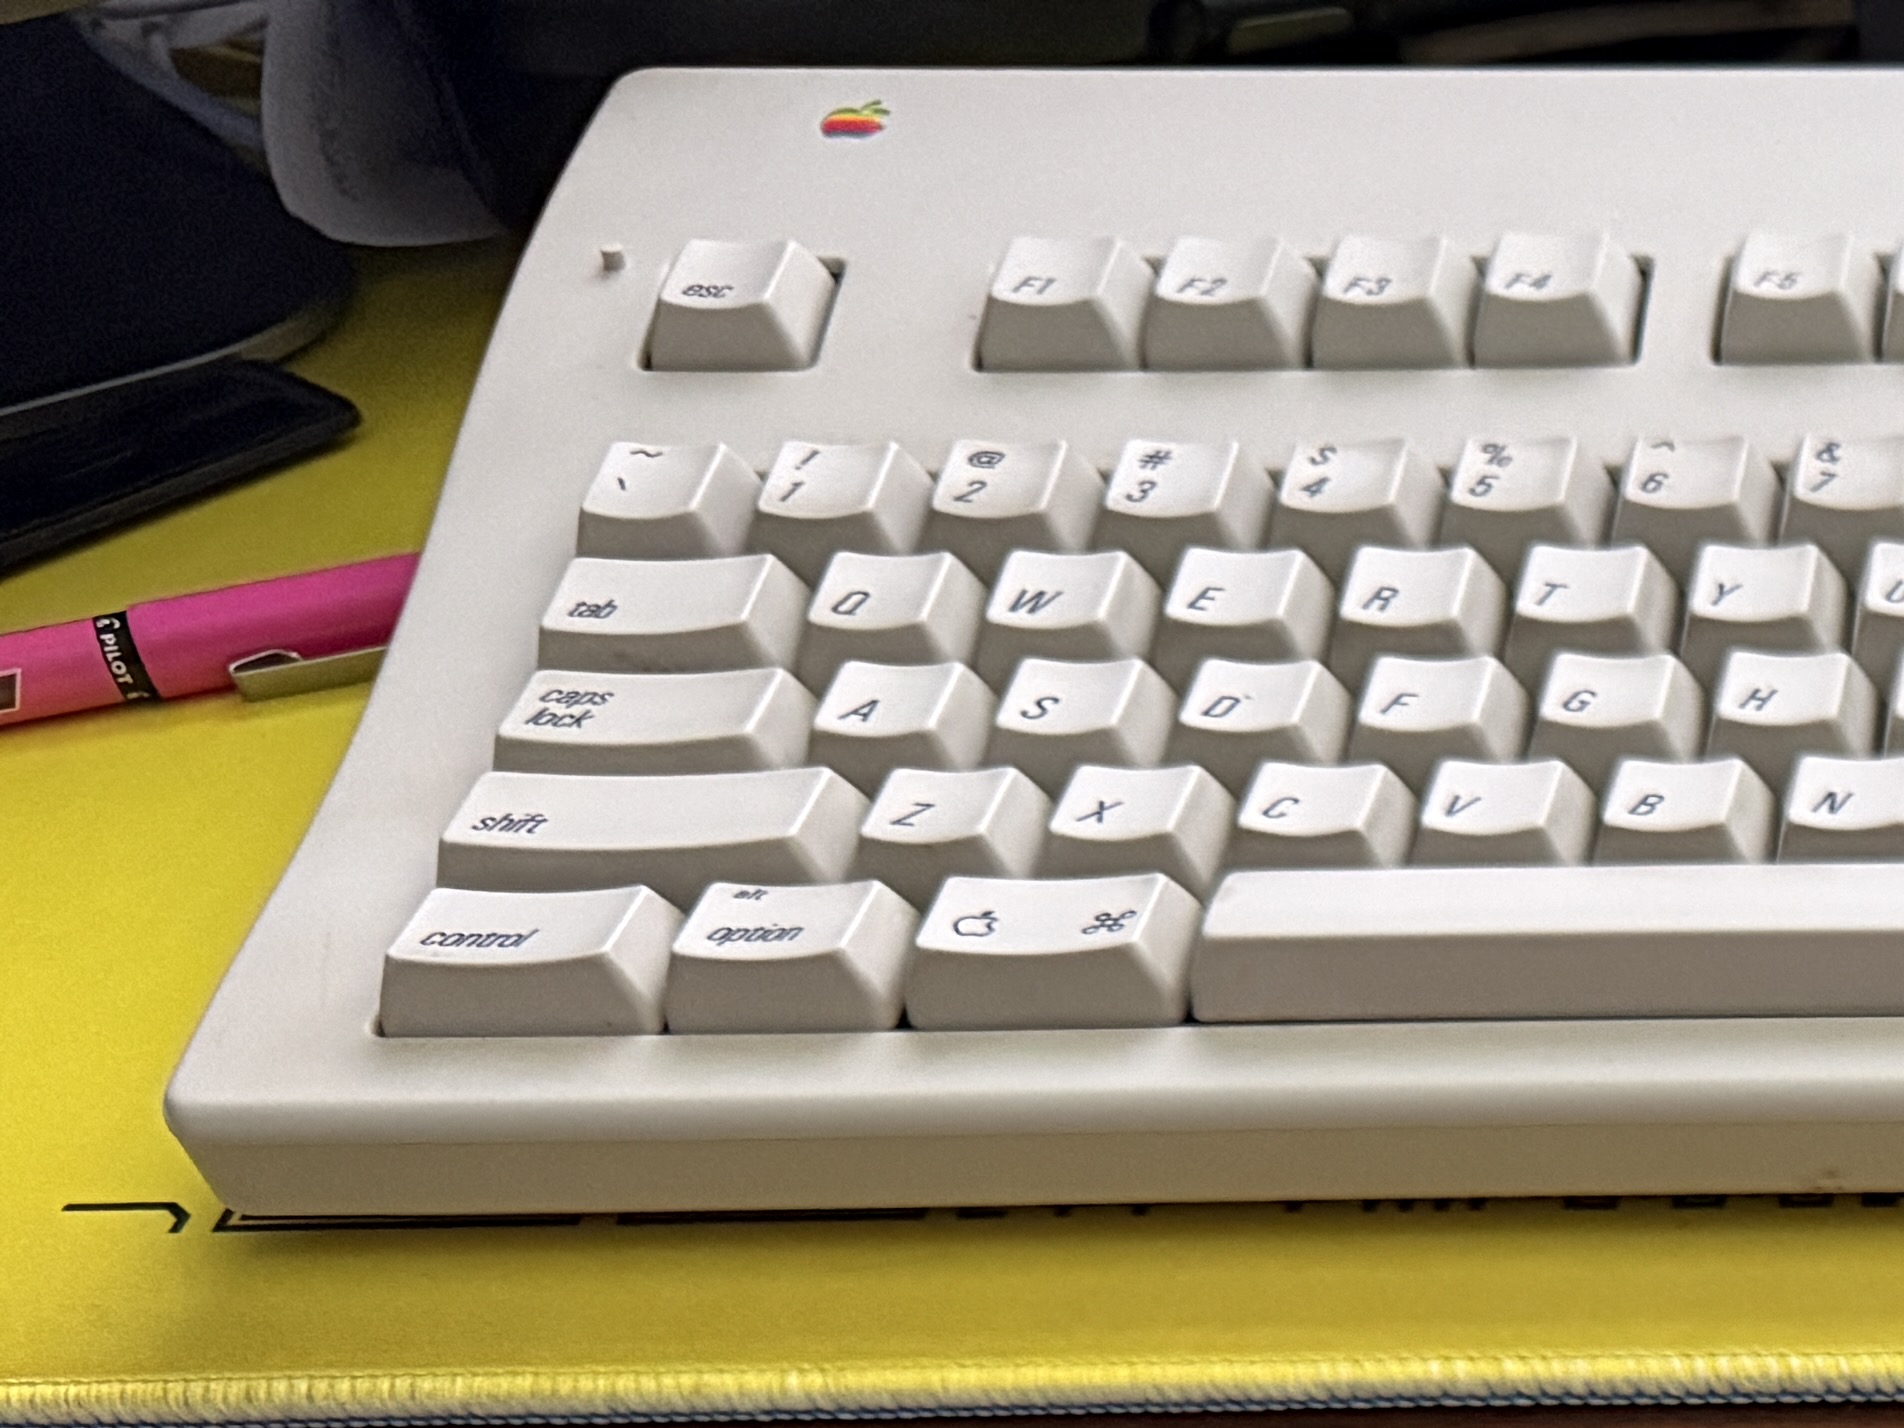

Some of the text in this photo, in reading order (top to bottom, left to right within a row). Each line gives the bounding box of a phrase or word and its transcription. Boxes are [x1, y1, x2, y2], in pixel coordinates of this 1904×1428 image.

[681, 283, 734, 299] esc
[1010, 275, 1057, 296] F1
[566, 599, 618, 620] tab
[830, 590, 871, 616] Q
[1007, 588, 1063, 615] W
[99, 632, 135, 685] PILOT
[538, 688, 615, 710] caps
[1019, 696, 1060, 720] S
[524, 706, 595, 729] lock
[837, 699, 880, 723] A
[471, 812, 549, 835] shift
[889, 801, 936, 827] Z
[419, 928, 540, 948] control
[705, 923, 805, 947] option
